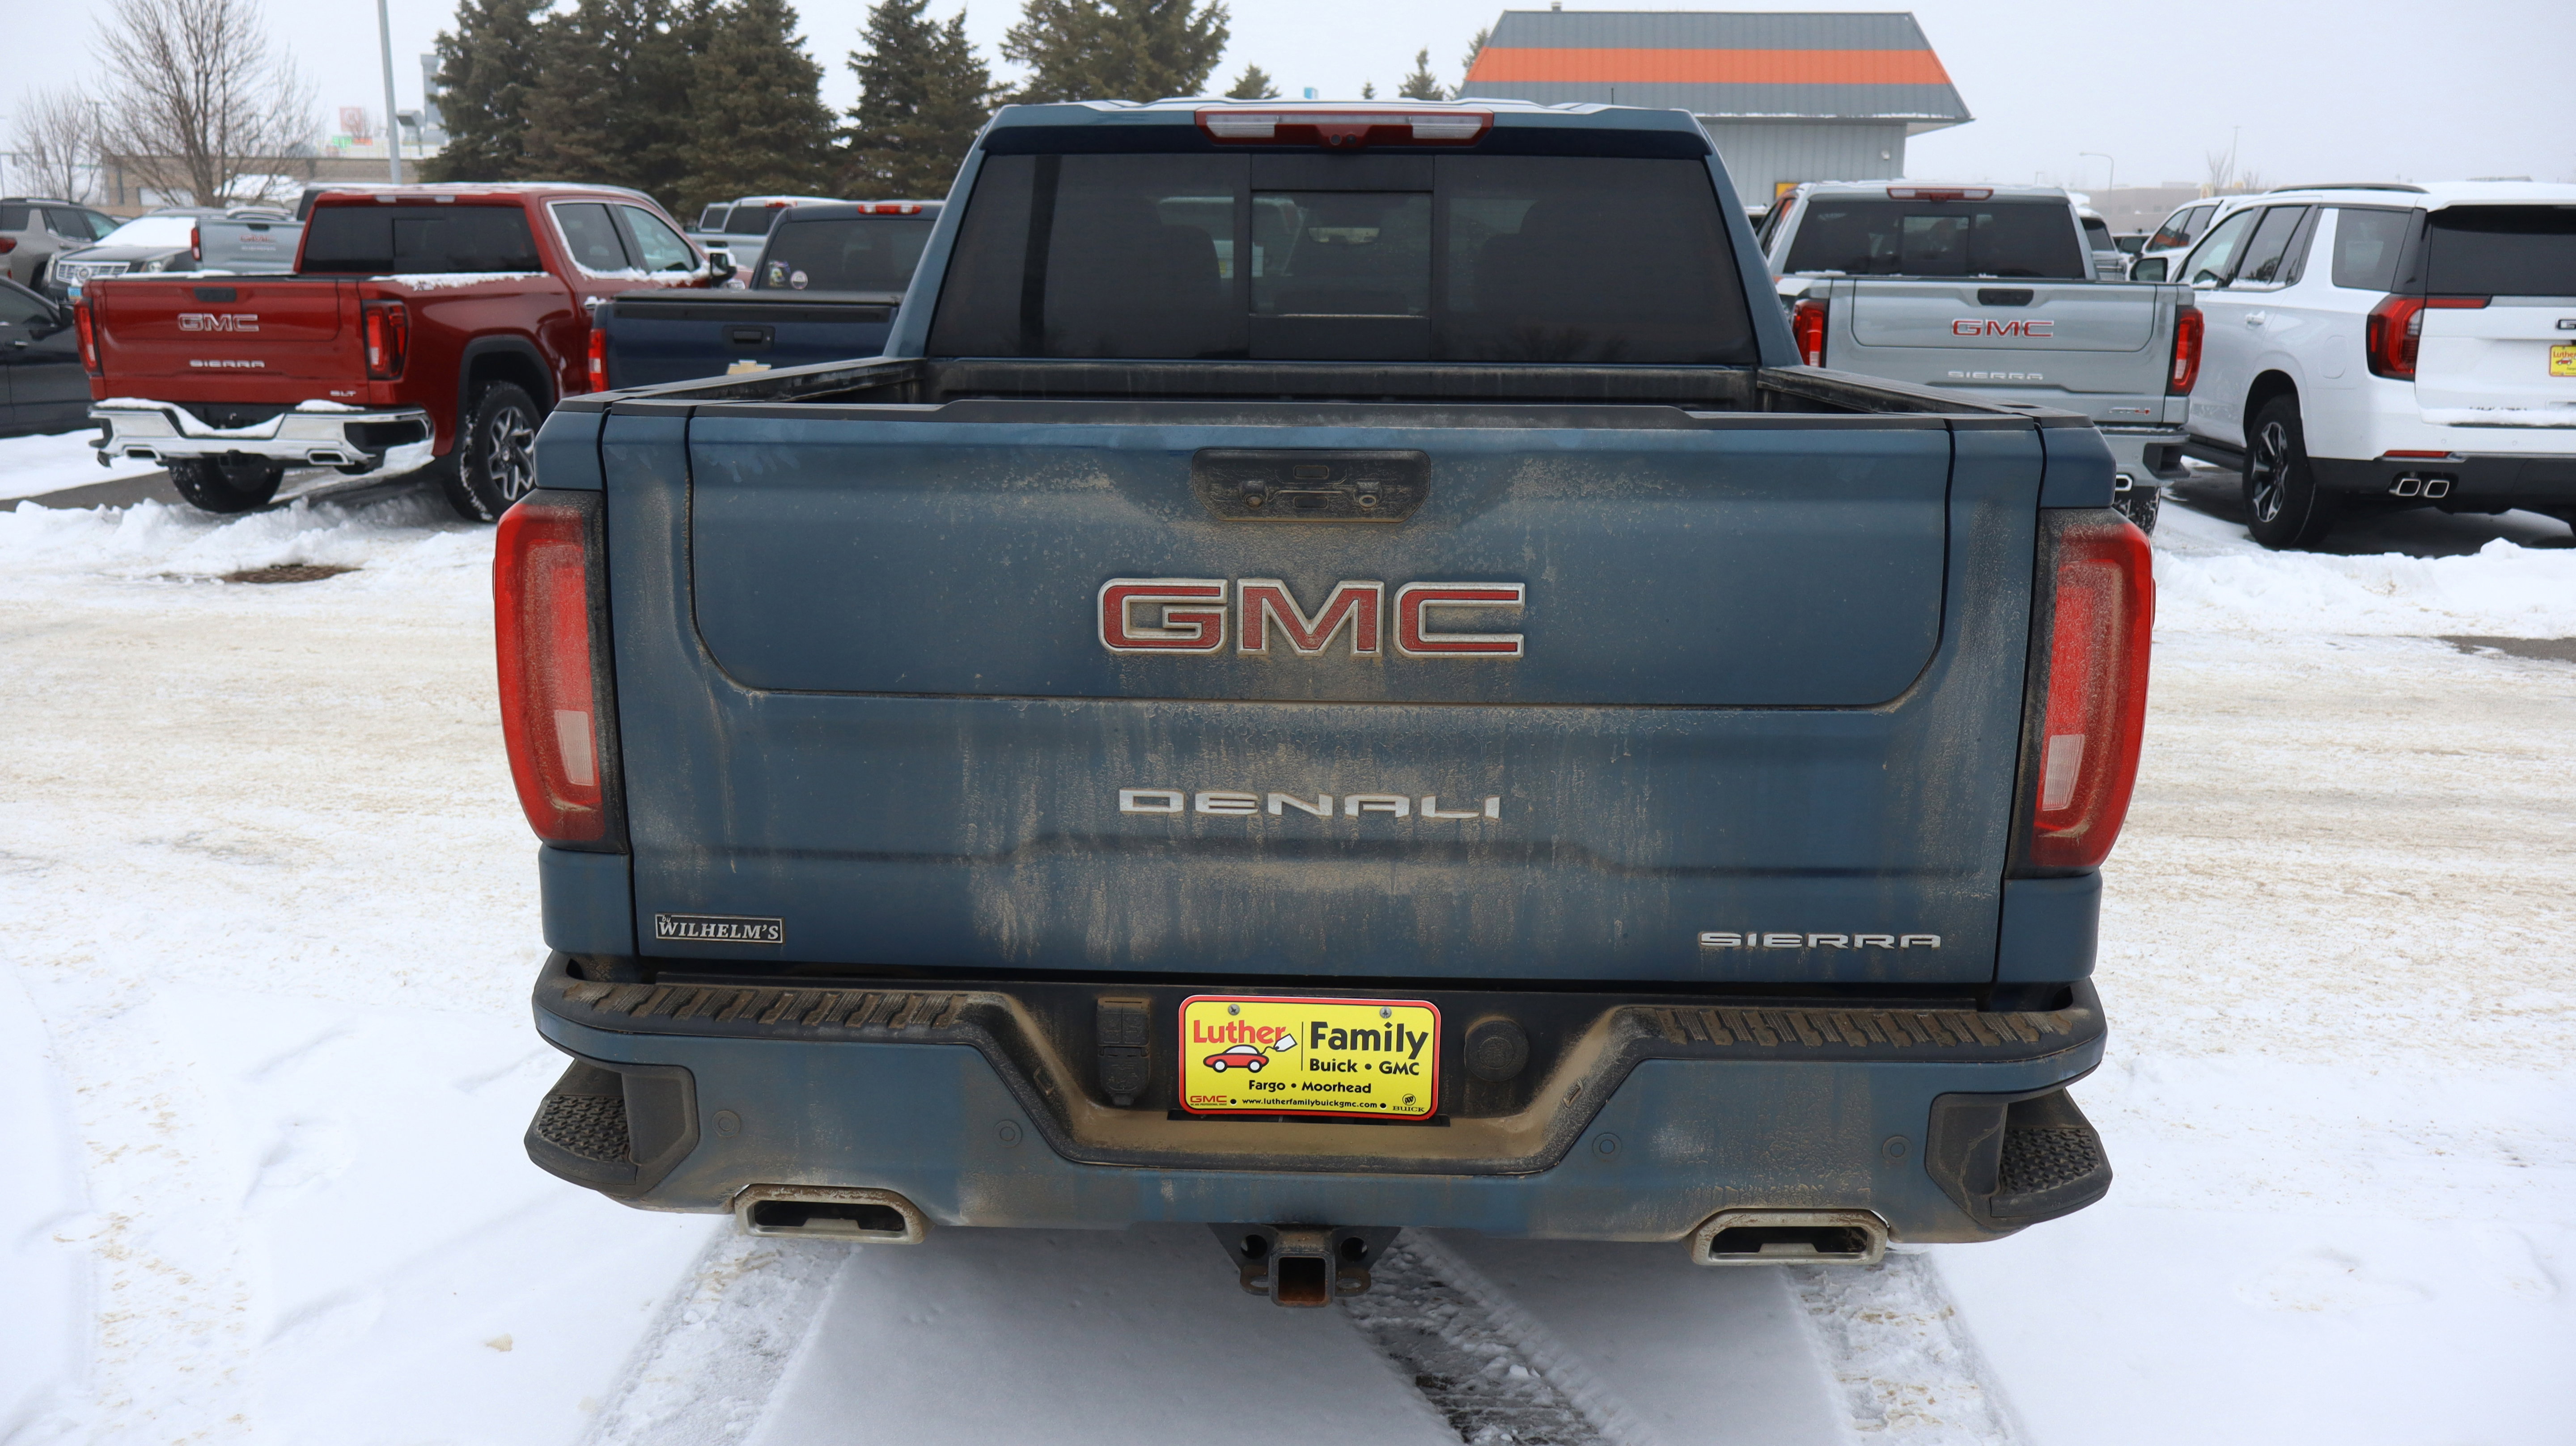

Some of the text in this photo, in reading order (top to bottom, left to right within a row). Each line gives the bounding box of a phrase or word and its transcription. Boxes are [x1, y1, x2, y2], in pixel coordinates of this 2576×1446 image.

[178, 314, 259, 332] GMC
[1952, 318, 2055, 338] GMC
[190, 360, 265, 368] SIERRA
[1948, 371, 2044, 380] SIERRA
[1098, 578, 1525, 658] GMC
[1119, 789, 1500, 819] DENALI
[659, 922, 779, 940] WILHELM'S
[1701, 933, 1941, 949] SIERRA
[1194, 1020, 1287, 1044] Luther
[1310, 1021, 1429, 1060] Family
[1310, 1058, 1419, 1075] Buick GMC
[1249, 1080, 1371, 1093] Fargo Moorhead
[1242, 1098, 1377, 1108] www.lutherfamilybuickgmc.com
